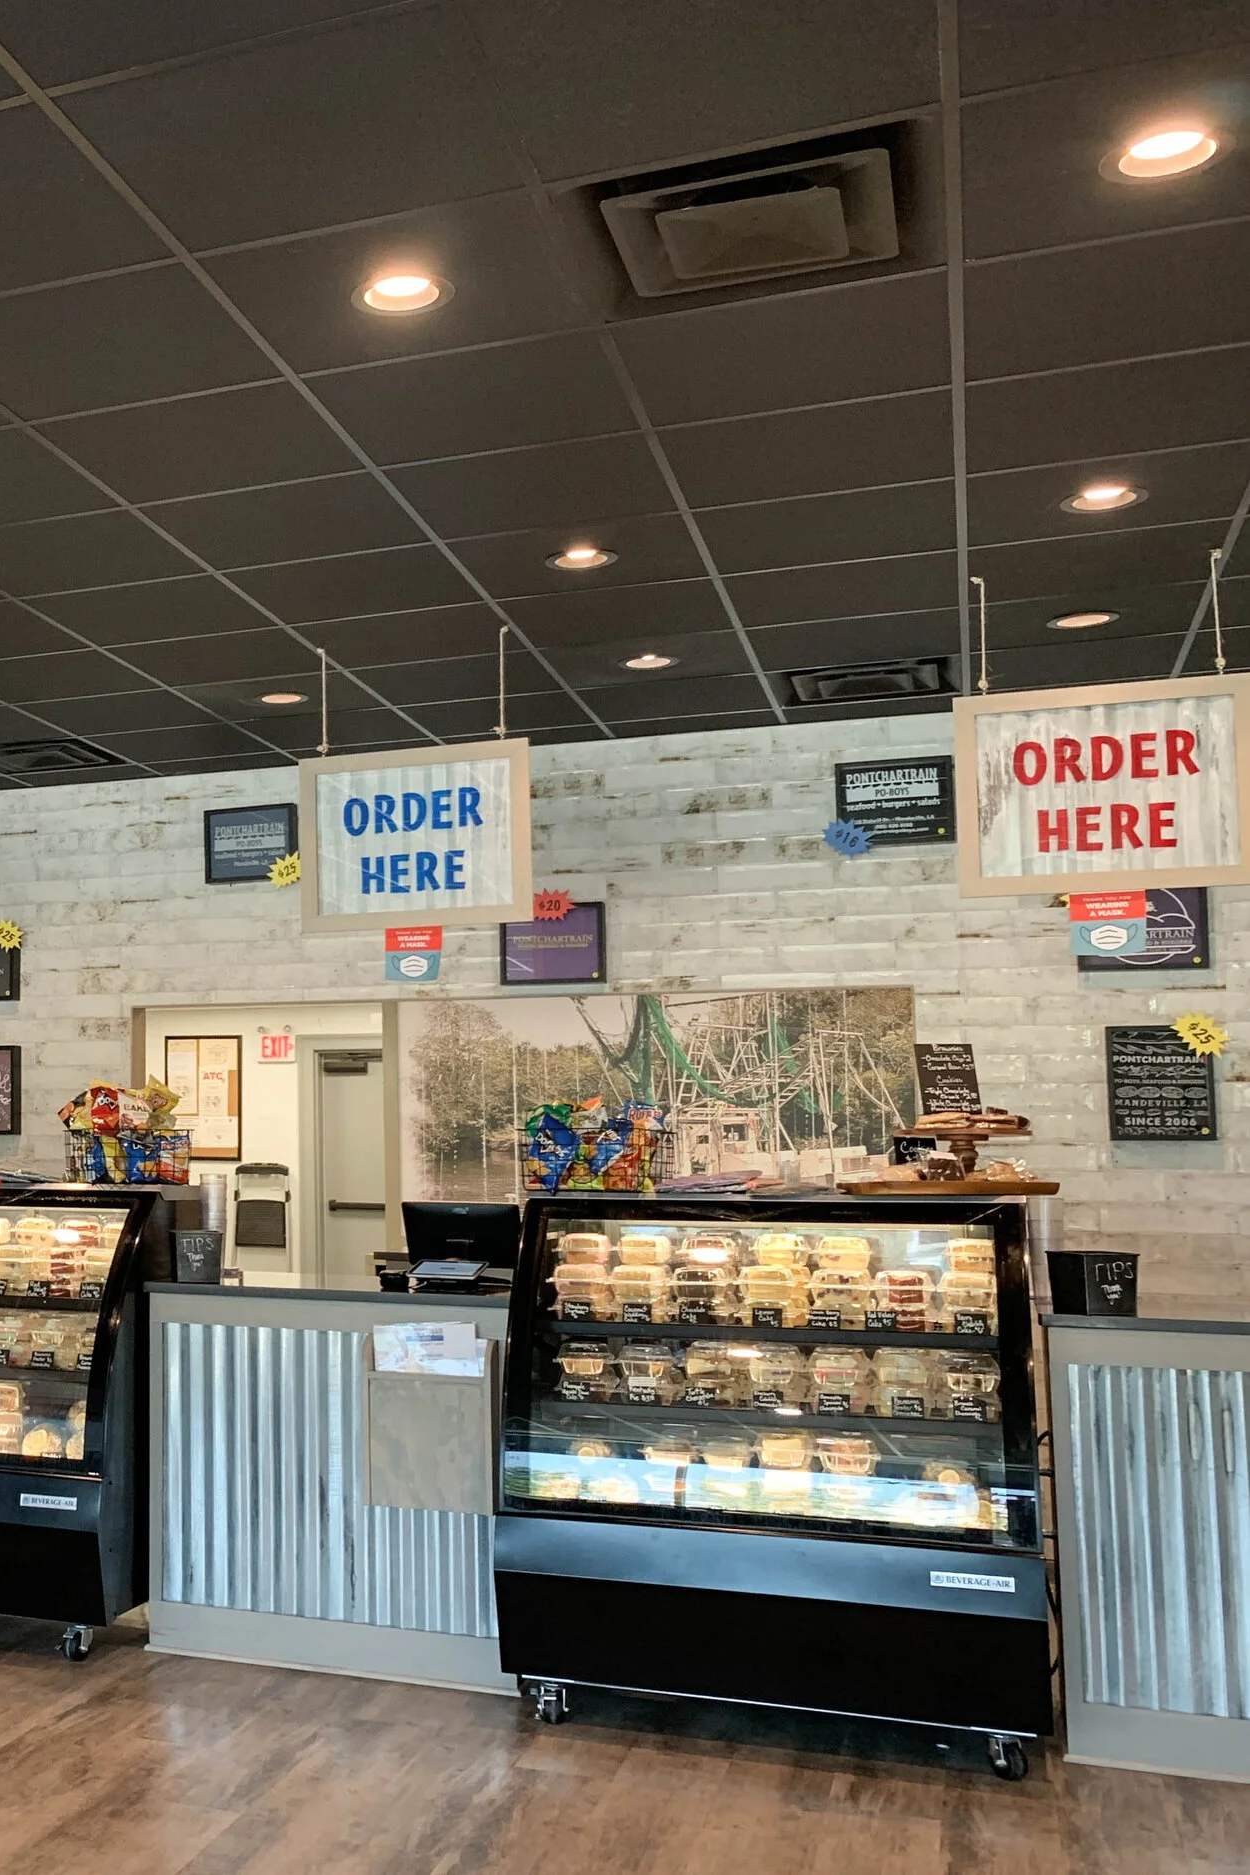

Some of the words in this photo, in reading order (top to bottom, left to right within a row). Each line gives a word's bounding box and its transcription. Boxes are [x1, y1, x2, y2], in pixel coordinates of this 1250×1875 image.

[1012, 729, 1200, 786] ORDER
[846, 768, 938, 785] PONTCHARTRAIN
[875, 787, 910, 797] PO-BOYS
[343, 786, 483, 837] ORDER
[846, 801, 876, 812] seafood
[882, 799, 911, 809] burgers
[917, 797, 941, 806] salads
[1037, 802, 1178, 853] HERE
[361, 850, 466, 895] HERE
[1085, 901, 1129, 909] WEARING
[261, 1035, 289, 1059] EXIT
[1113, 1055, 1205, 1064] PONTCHARTRAIN
[1114, 1099, 1191, 1108] MANDEVILLE,
[1193, 1099, 1208, 1107] LA
[1124, 1117, 1161, 1126] SINCE
[1165, 1117, 1197, 1126] 2006
[180, 1237, 214, 1253] TIPS
[1095, 1261, 1134, 1282] TIPS
[867, 1319, 883, 1328] Cake
[31, 1497, 74, 1506] BEVERAGE-AIR
[946, 1576, 1010, 1588] BEVERAGE-AIR
